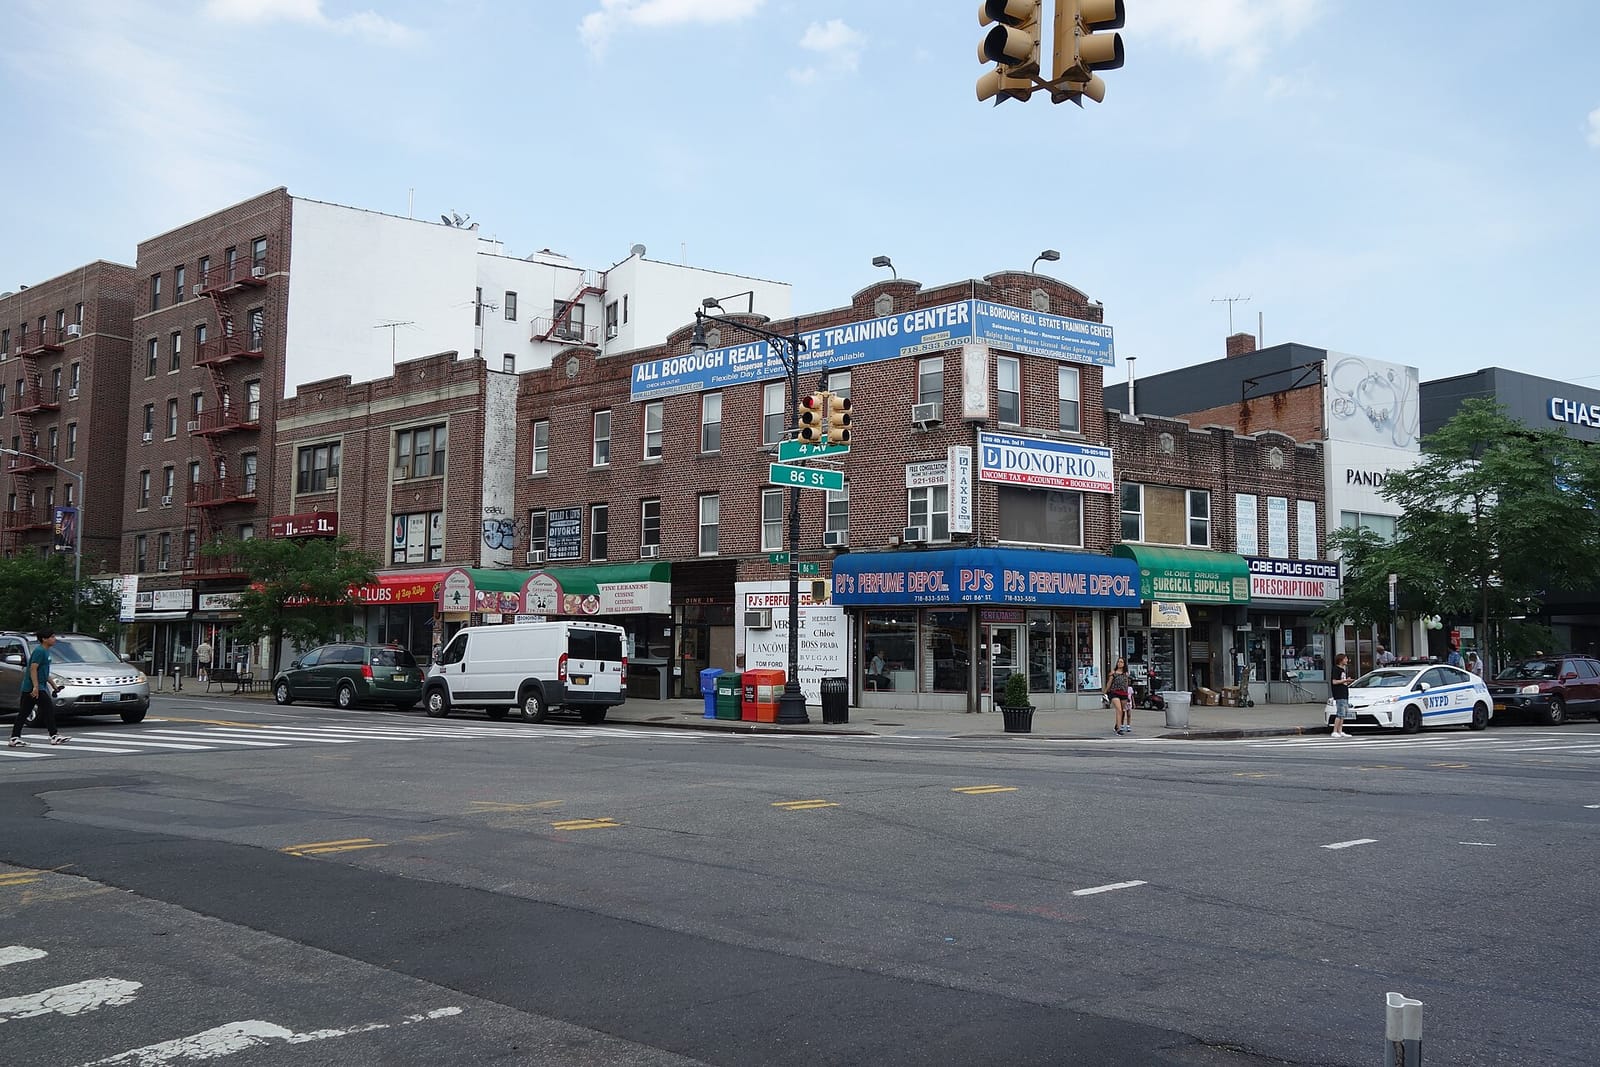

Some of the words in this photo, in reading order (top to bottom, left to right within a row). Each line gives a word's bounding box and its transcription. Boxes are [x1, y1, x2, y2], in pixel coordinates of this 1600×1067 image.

[976, 302, 988, 316] ALL
[990, 306, 1020, 322] BOROUGH
[1021, 313, 1036, 325] REAL
[1039, 317, 1060, 329] ESTATE
[1062, 321, 1089, 334] TRAINING
[1090, 326, 1112, 338] CENTER
[637, 362, 658, 382] ALL
[662, 351, 723, 377] BOROUGH
[729, 345, 762, 364] REAL
[824, 318, 898, 346] TRAINING
[904, 302, 968, 333] CENTER
[901, 337, 970, 355] 718.833.8050
[712, 372, 741, 383] Flexible
[740, 369, 754, 379] Day
[828, 352, 864, 363] Available
[733, 362, 763, 372] Salesperson
[812, 349, 834, 358] Courses
[1551, 398, 1600, 427] CHAS
[800, 444, 807, 454] 4
[812, 442, 827, 452] Av
[1006, 450, 1095, 477] DONOFRIO
[1098, 471, 1110, 479] INC.
[790, 470, 805, 482] 86
[812, 473, 824, 485] St
[984, 470, 1007, 480] INCOME
[1028, 476, 1064, 485] ACCOUNTING
[1071, 480, 1110, 490] BOOKKEEPING
[550, 526, 580, 536] DIVORCE
[1275, 563, 1302, 574] DRUG
[1305, 564, 1336, 577] STORE
[836, 574, 854, 593] PJ's
[858, 572, 904, 593] PERFUME
[960, 569, 994, 592] PJ's
[1004, 570, 1025, 592] PJ's
[1029, 572, 1087, 594] PERFUME
[1153, 577, 1192, 592] SURGICAL
[1194, 579, 1230, 594] SUPPLIES
[1253, 578, 1324, 597] PRESCRIPTIONS
[358, 586, 392, 601] CLUBS
[748, 595, 762, 606] PJ's
[764, 595, 790, 606] PERFU
[801, 640, 818, 649] BOSS
[1429, 695, 1449, 708] NYPD
